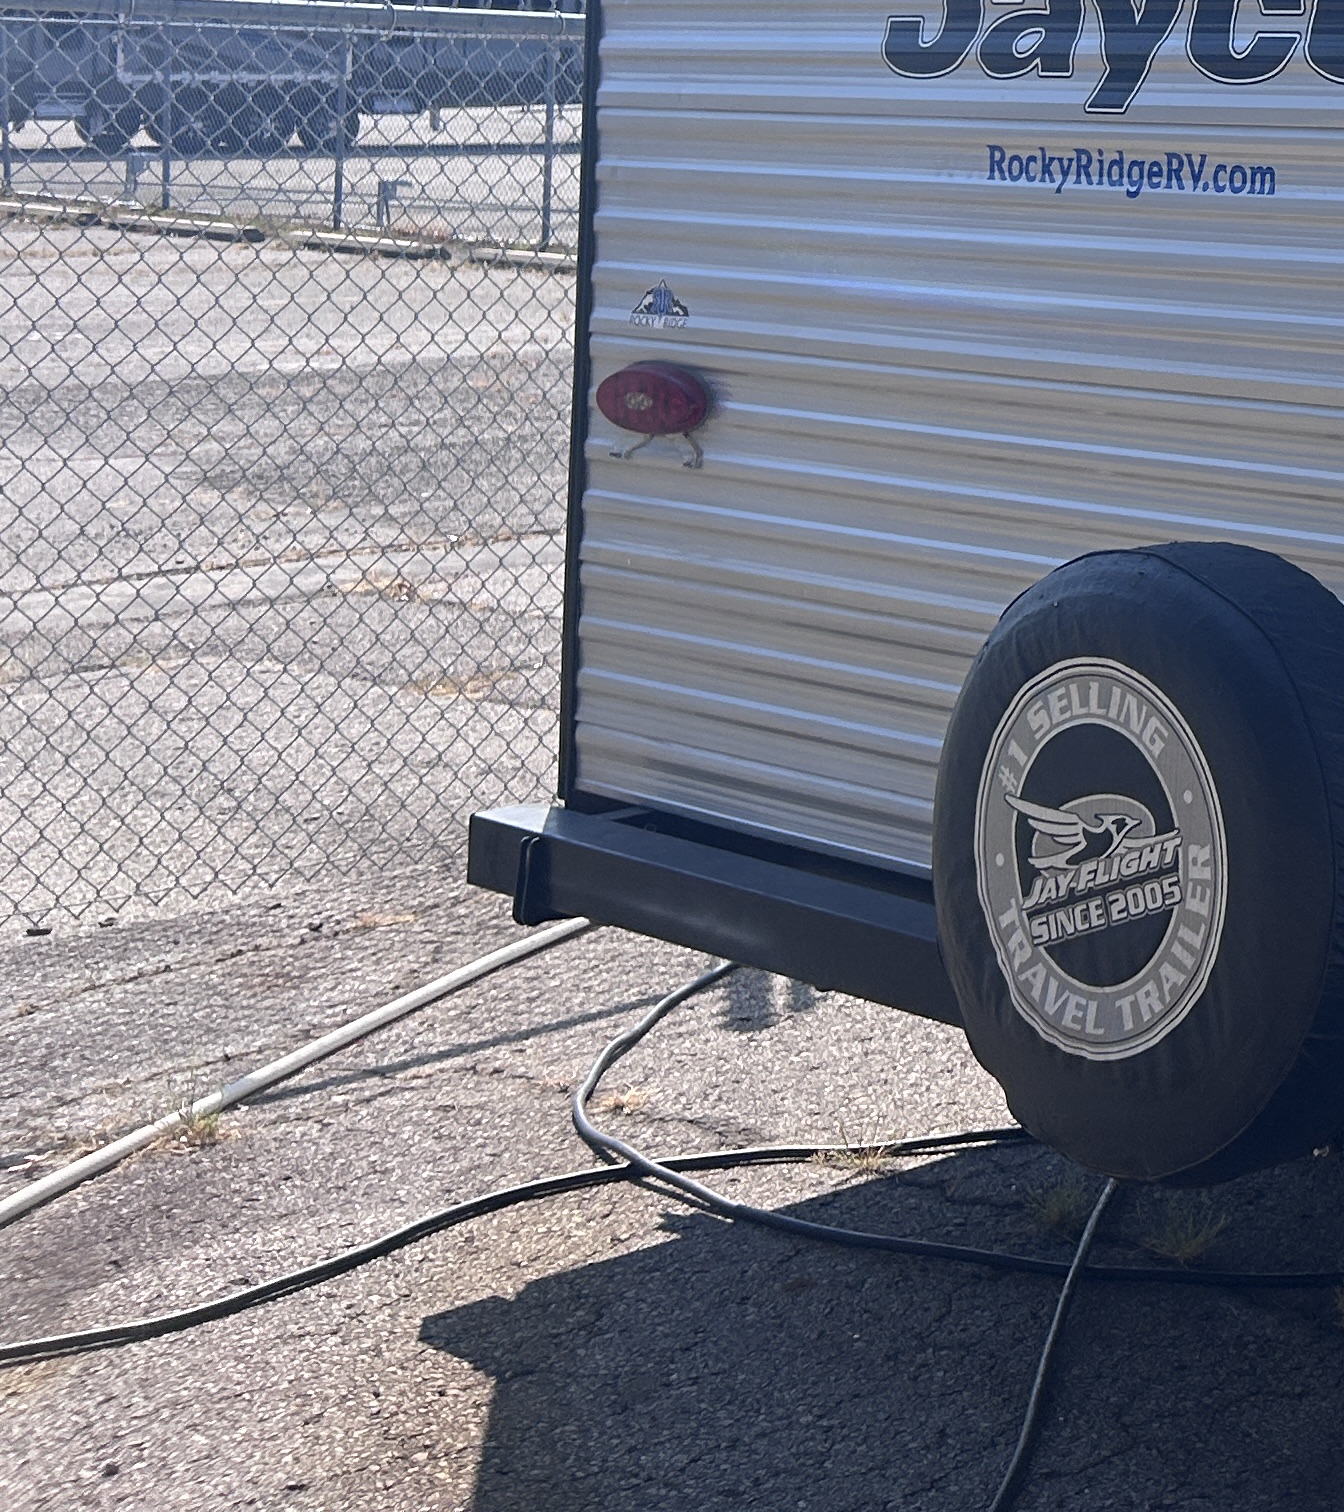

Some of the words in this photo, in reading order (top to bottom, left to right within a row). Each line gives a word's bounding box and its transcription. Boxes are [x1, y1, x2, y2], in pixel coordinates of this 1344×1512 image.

[986, 144, 1277, 199] RockyRidgeRV.com
[1026, 681, 1169, 759] SELLING
[998, 897, 1105, 1035] TRAVEL
[1115, 843, 1212, 1032] TRAILER
[1030, 899, 1106, 946] SINCE
[1108, 875, 1182, 922] 2005
